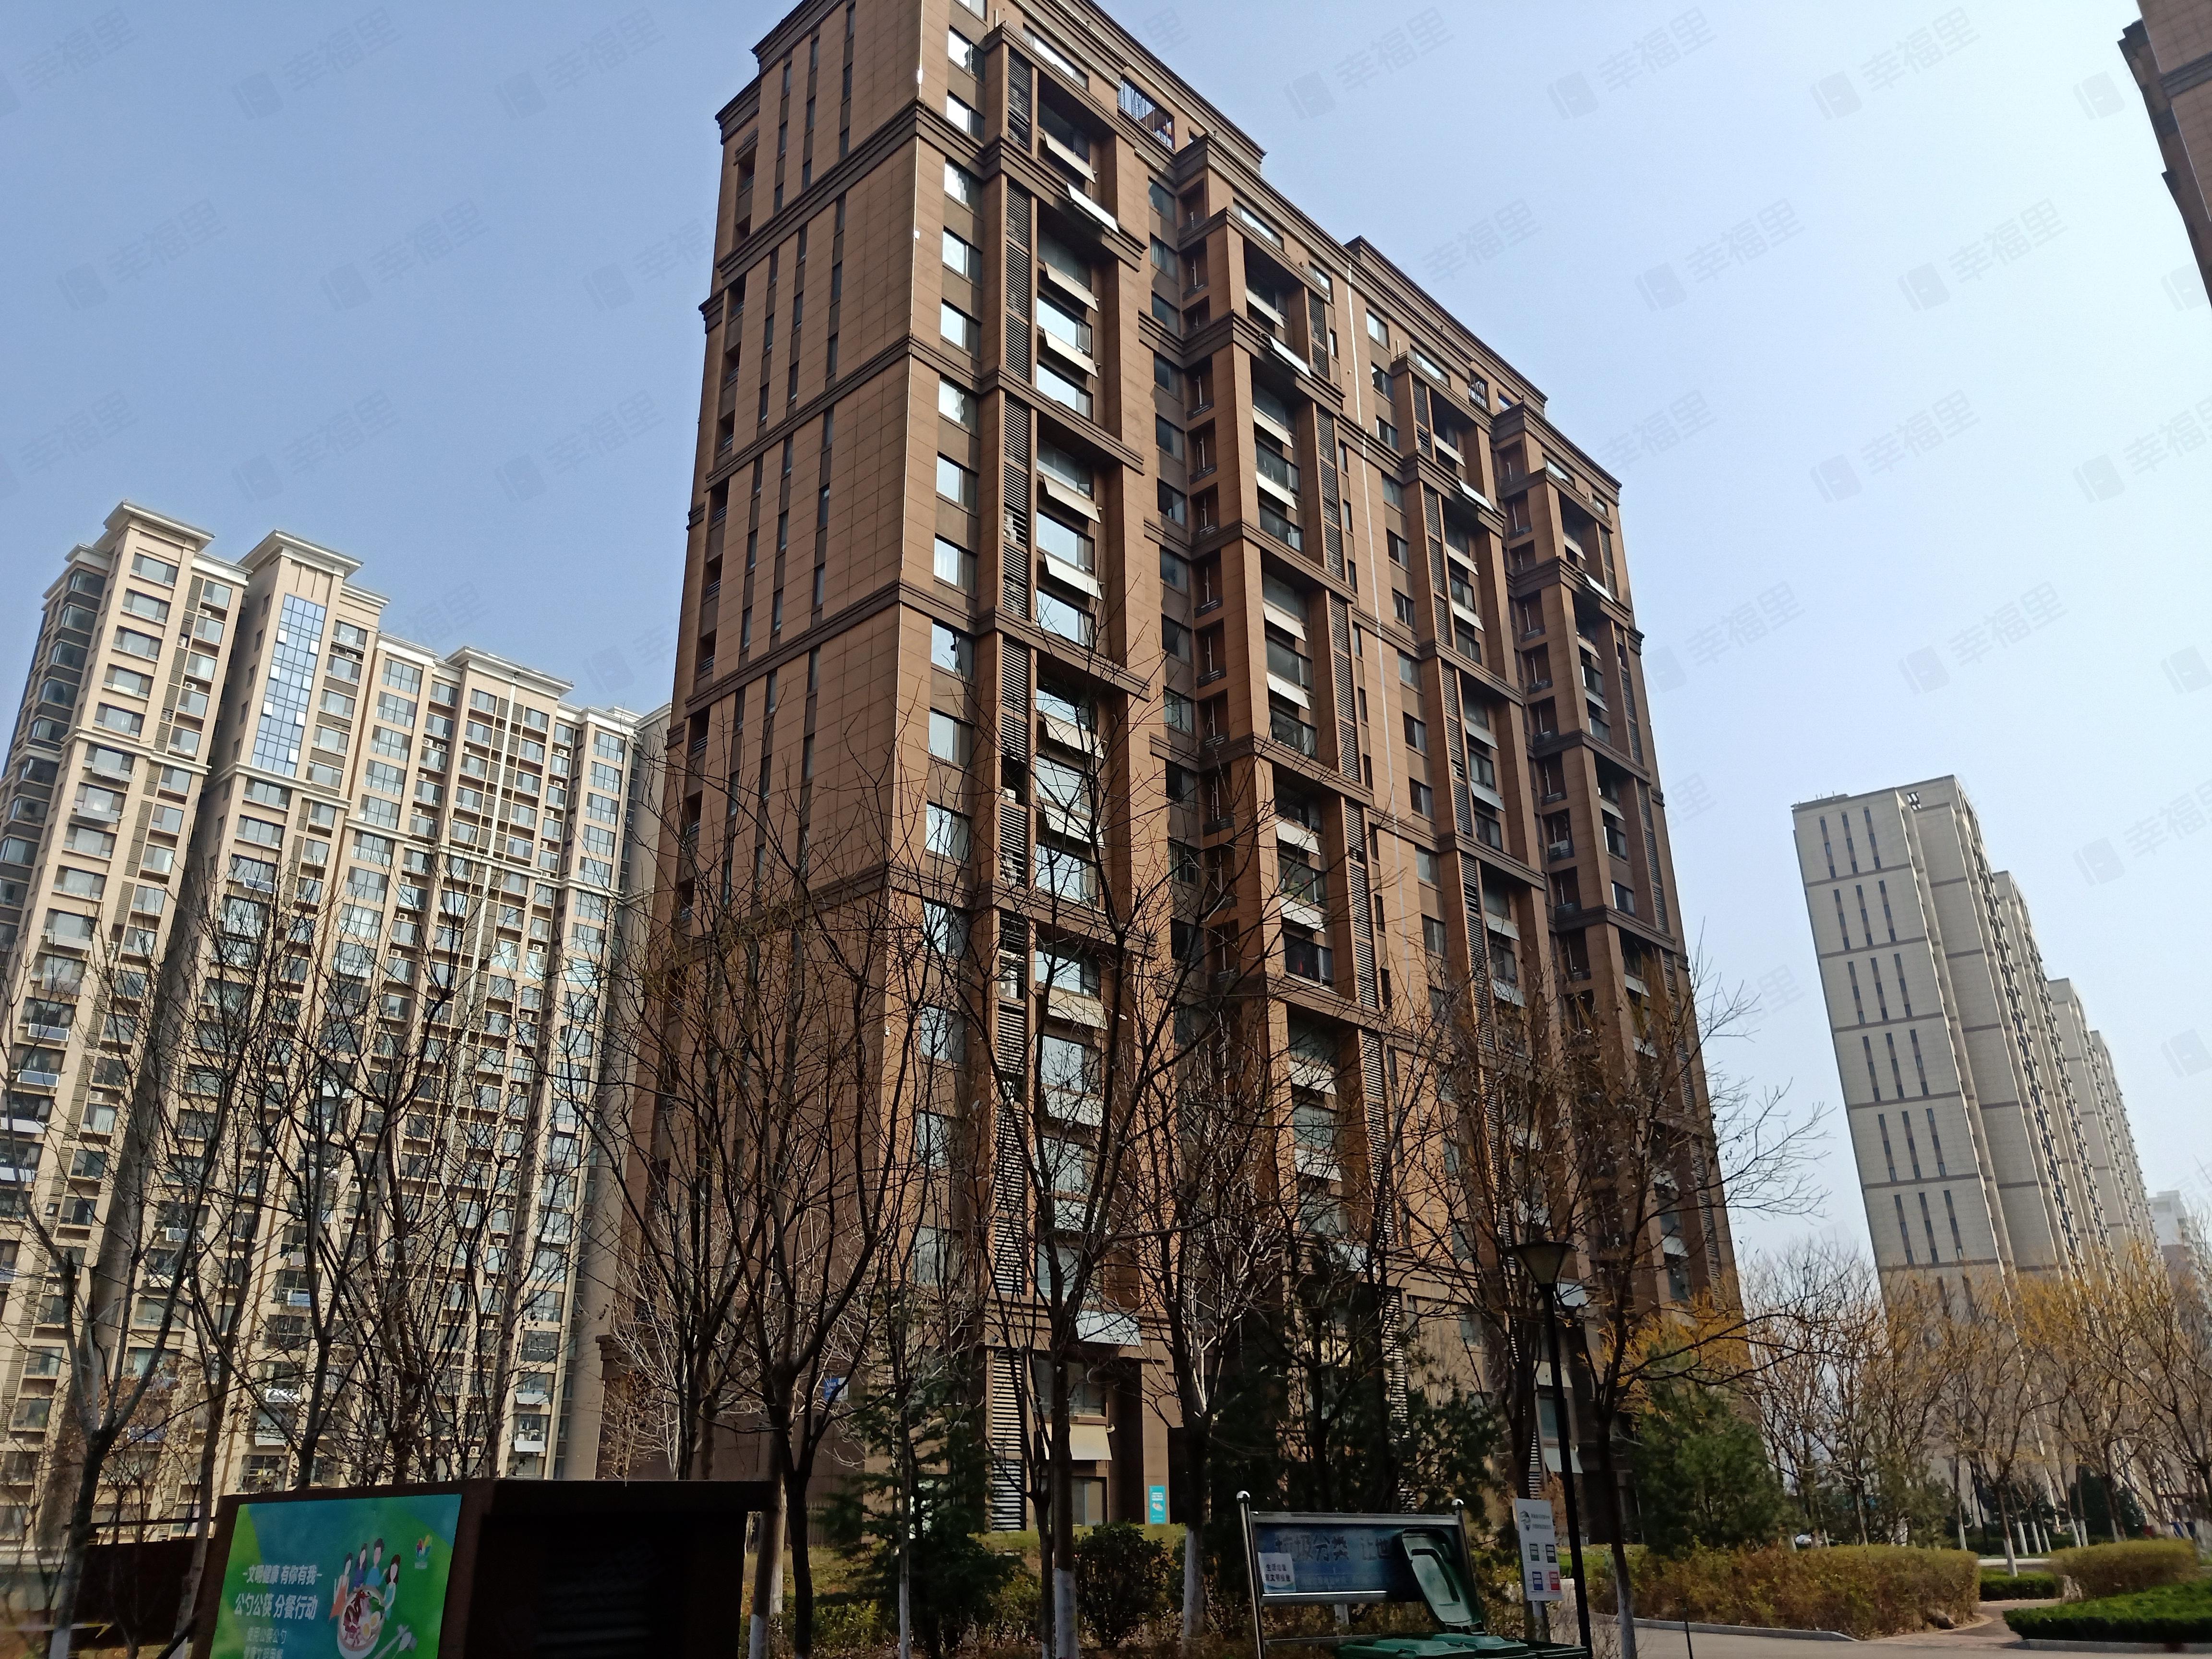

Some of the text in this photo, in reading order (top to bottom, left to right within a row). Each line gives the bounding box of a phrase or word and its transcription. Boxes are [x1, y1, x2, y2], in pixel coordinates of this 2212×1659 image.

[247, 1564, 317, 1585] 文明健康 有你有我
[234, 1593, 318, 1620] 公勺公筷 分餐行动
